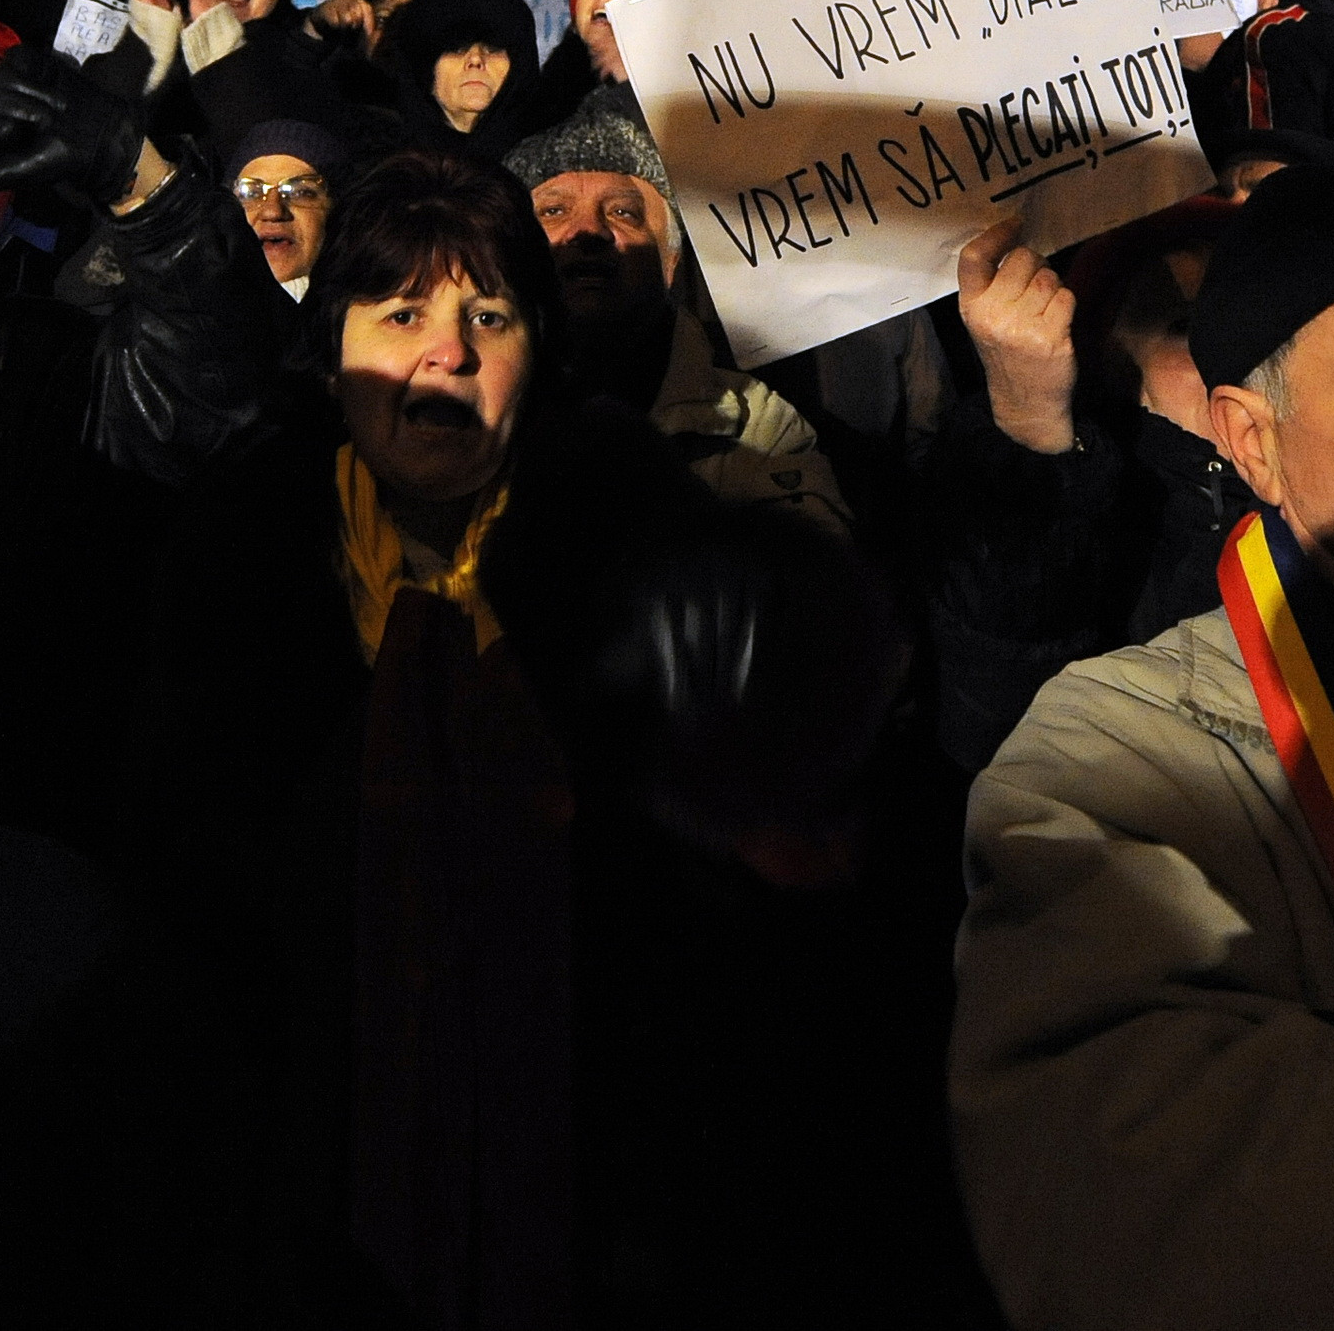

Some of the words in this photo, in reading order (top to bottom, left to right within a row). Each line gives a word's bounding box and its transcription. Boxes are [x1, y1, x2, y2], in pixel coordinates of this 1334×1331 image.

[687, 32, 777, 125] NU
[709, 153, 879, 270] VREM
[878, 101, 966, 209] SĂ
